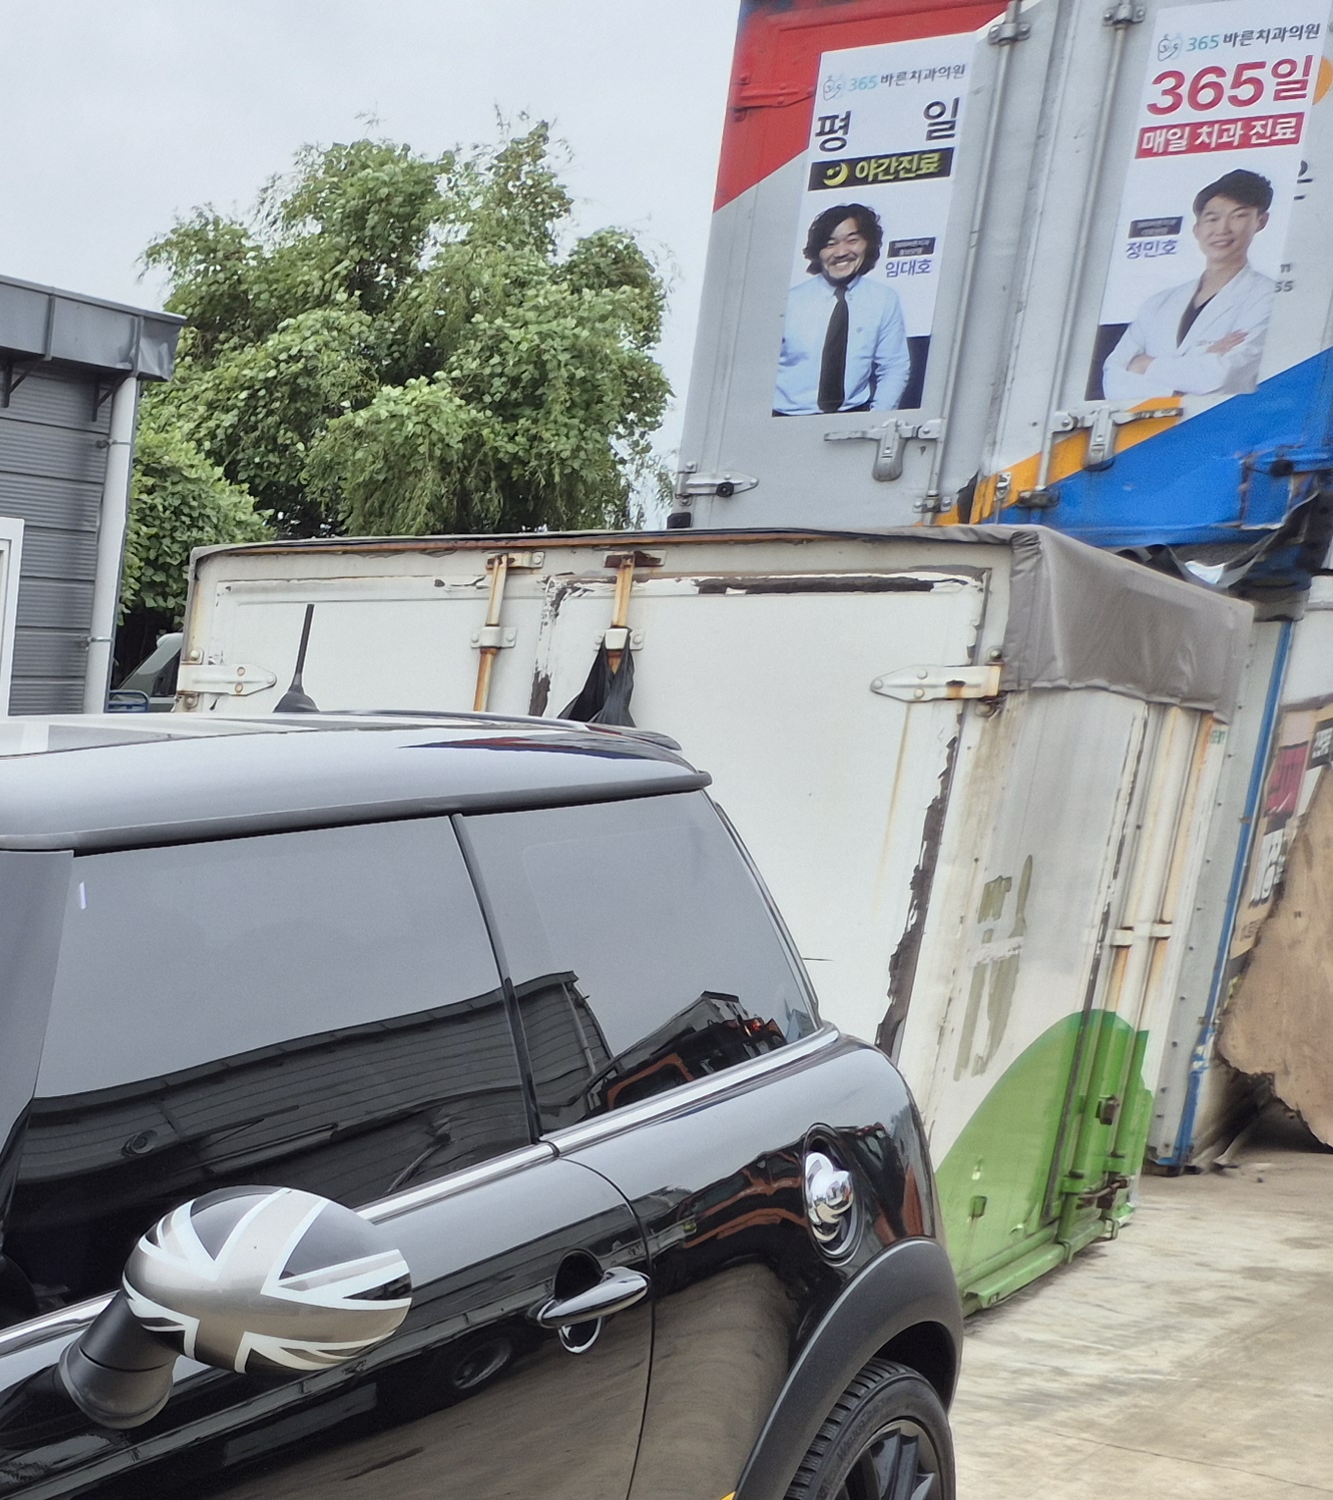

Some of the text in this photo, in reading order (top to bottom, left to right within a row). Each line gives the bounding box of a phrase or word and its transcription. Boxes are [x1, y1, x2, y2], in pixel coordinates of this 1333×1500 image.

[1146, 55, 1314, 116] 365일
[1141, 117, 1298, 154] 매일 치과 진료
[855, 152, 943, 182] 야간진료
[1126, 239, 1178, 259] 정민호
[885, 259, 932, 278] 임대호
